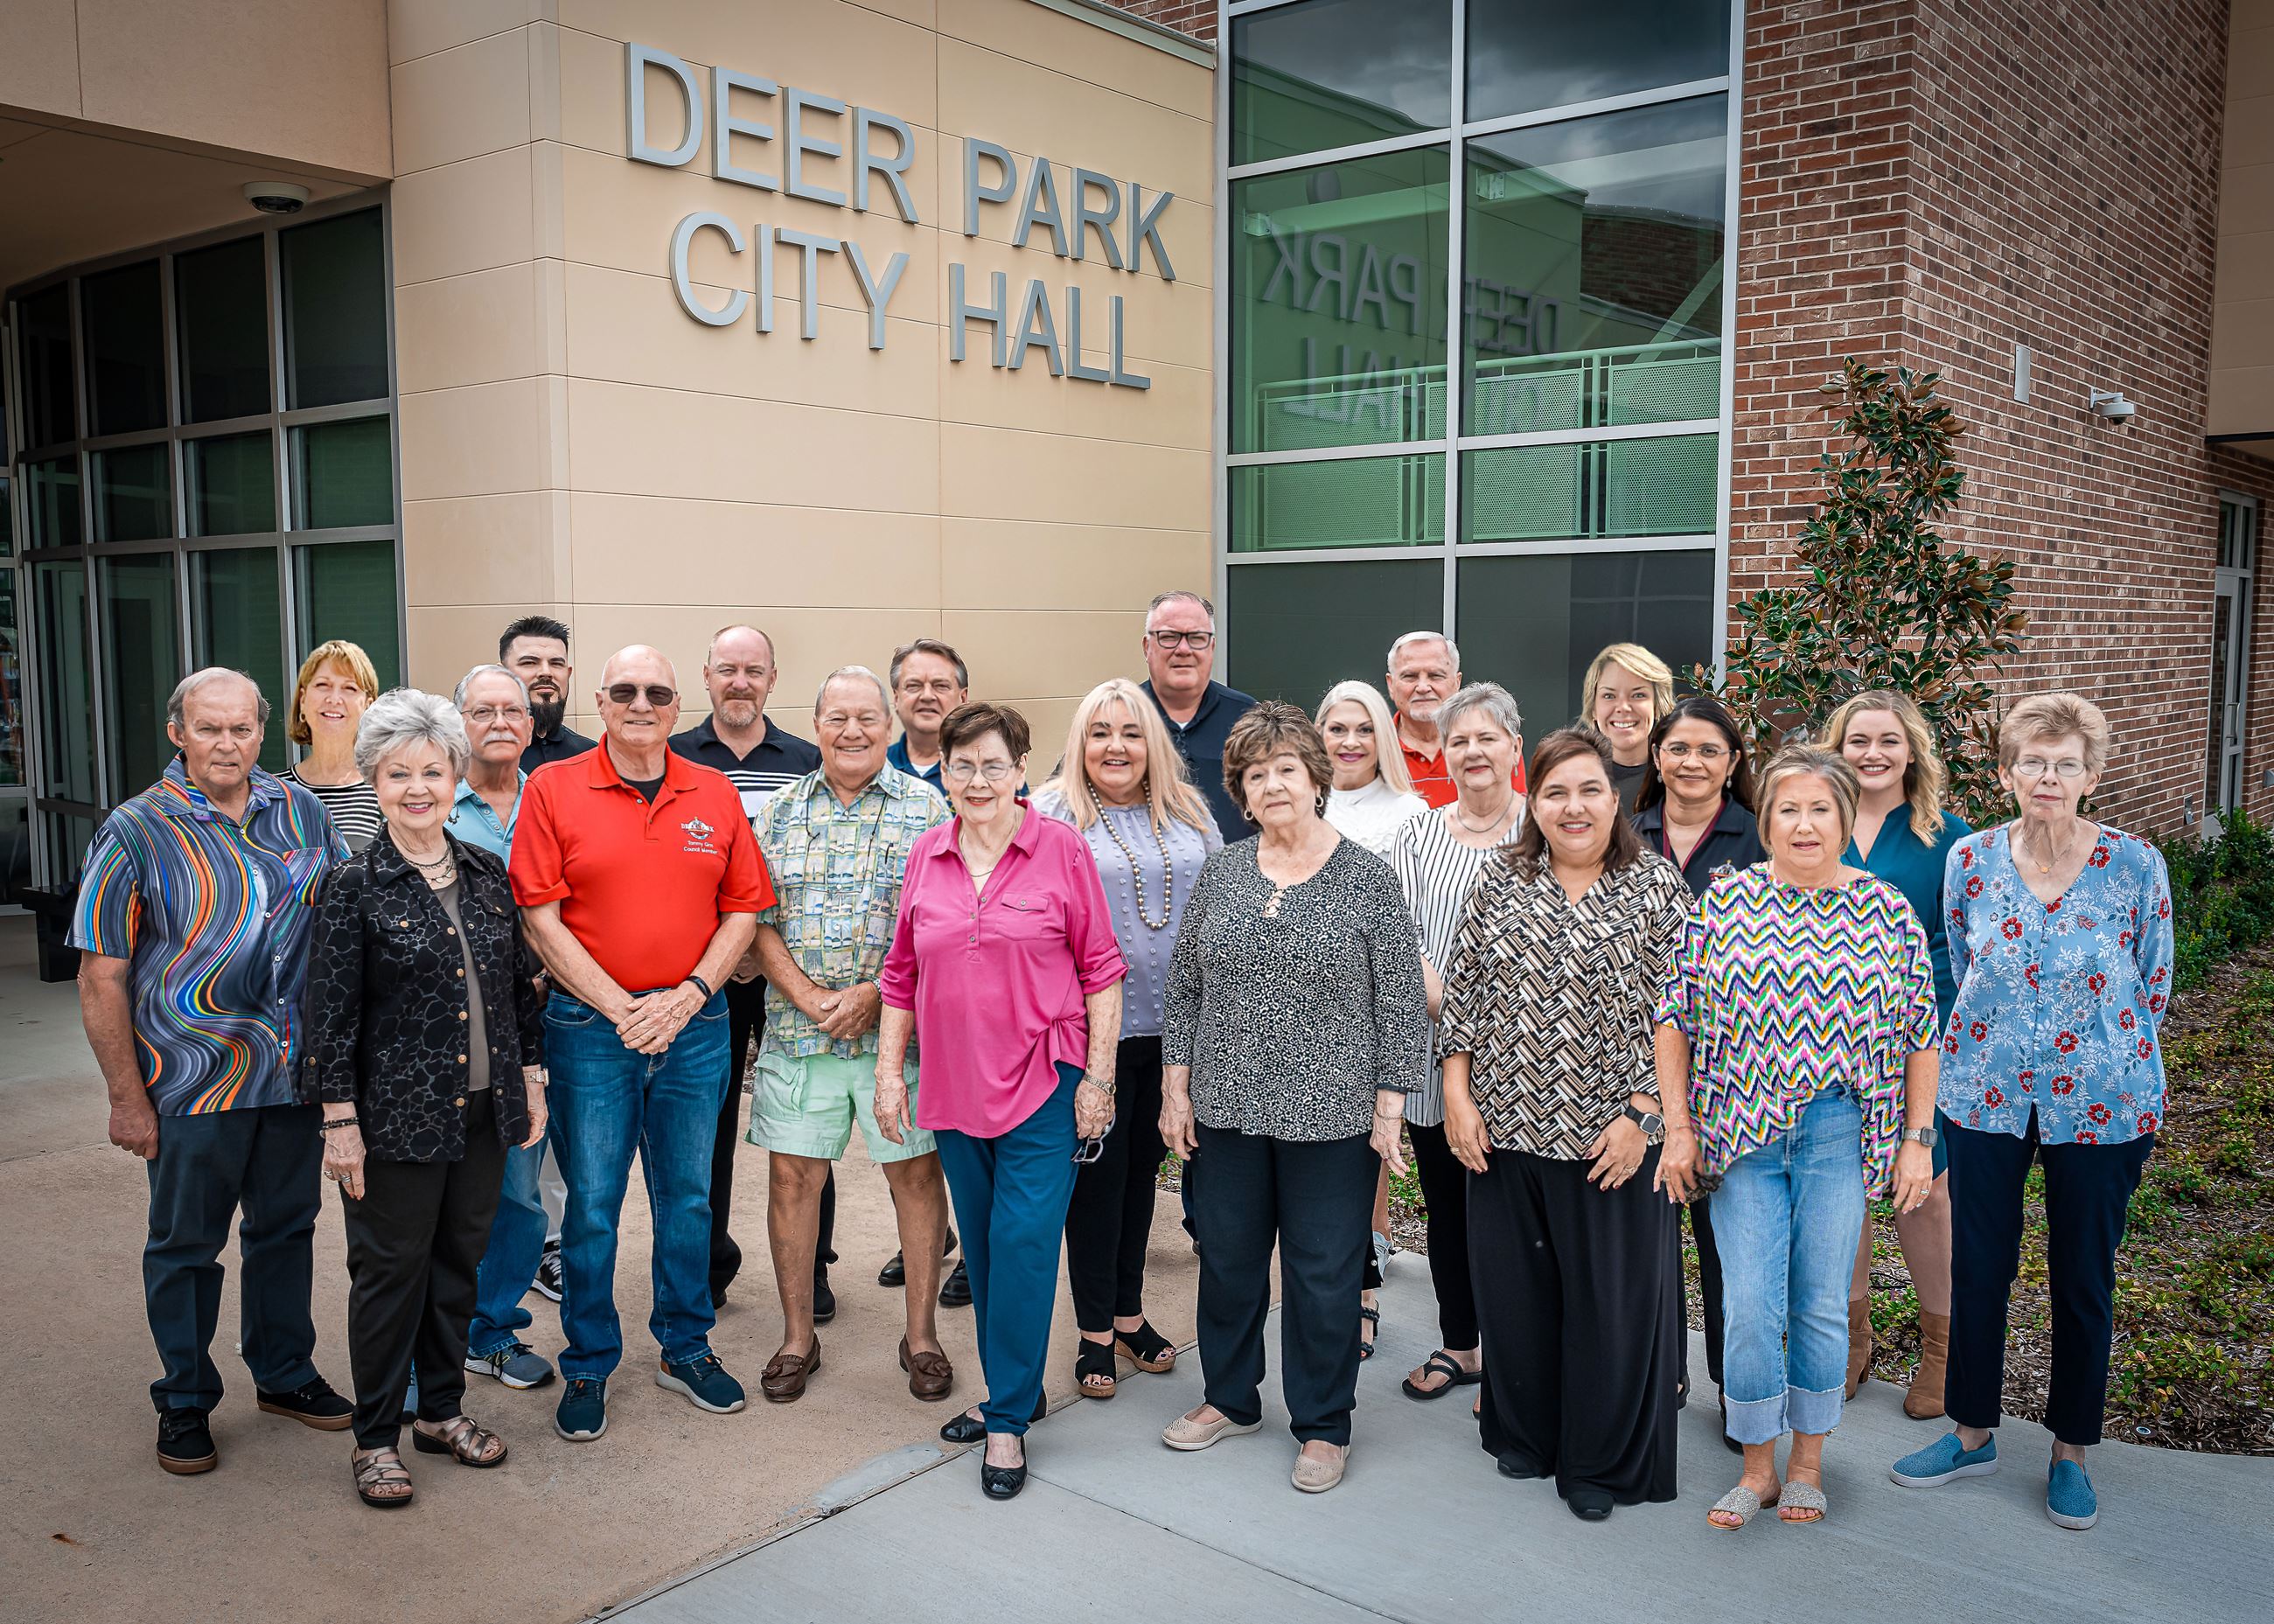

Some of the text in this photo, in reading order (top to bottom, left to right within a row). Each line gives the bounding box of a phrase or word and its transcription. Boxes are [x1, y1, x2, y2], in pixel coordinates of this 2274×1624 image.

[624, 41, 1176, 281] DEER PARK
[669, 212, 1151, 390] CITY HALL
